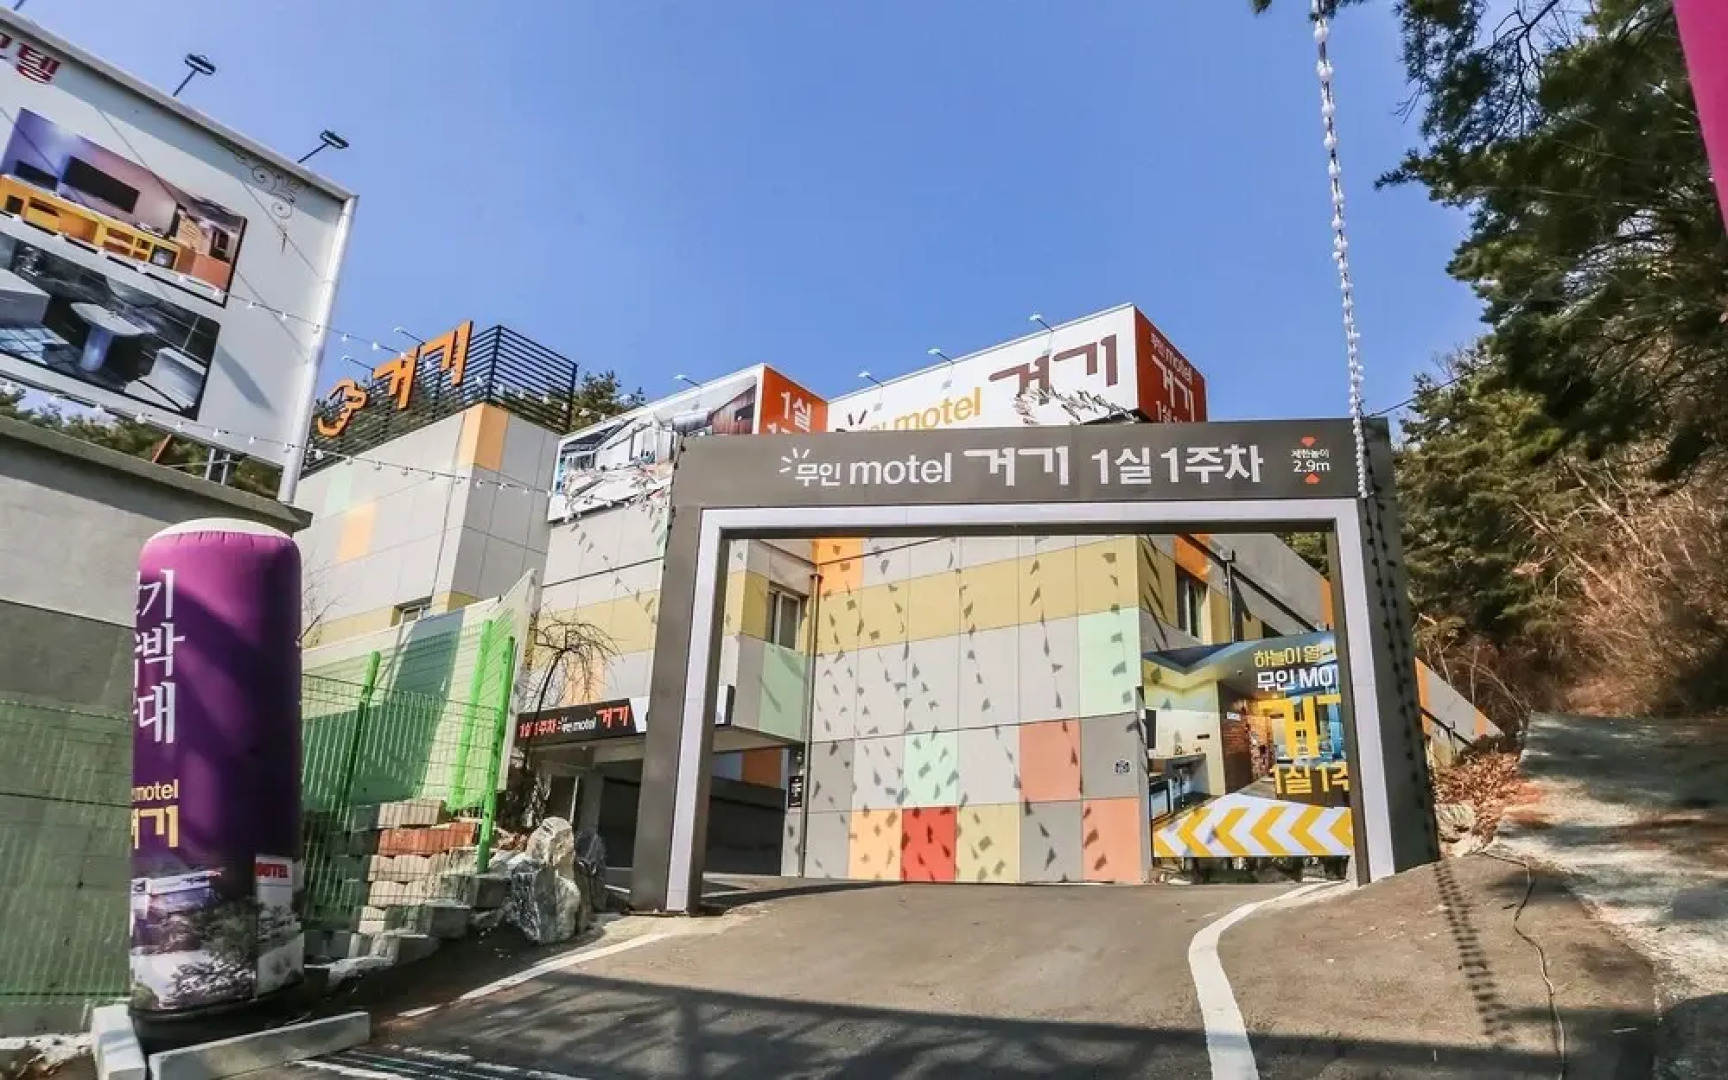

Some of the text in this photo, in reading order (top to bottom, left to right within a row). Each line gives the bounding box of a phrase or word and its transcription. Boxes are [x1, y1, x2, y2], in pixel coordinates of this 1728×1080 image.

[372, 320, 473, 410] 거기
[988, 333, 1118, 406] 거기
[894, 386, 981, 431] motel
[1152, 354, 1195, 422] 거기
[780, 391, 812, 433] 1실
[795, 443, 1265, 487] 무인 motel 거기 1실 1주차
[1292, 459, 1331, 473] 2.9m
[1254, 647, 1301, 668] 하늘이
[1257, 668, 1296, 692] 무인
[133, 682, 176, 744] 대
[596, 705, 630, 729] 거기
[1269, 764, 1313, 794] 1실
